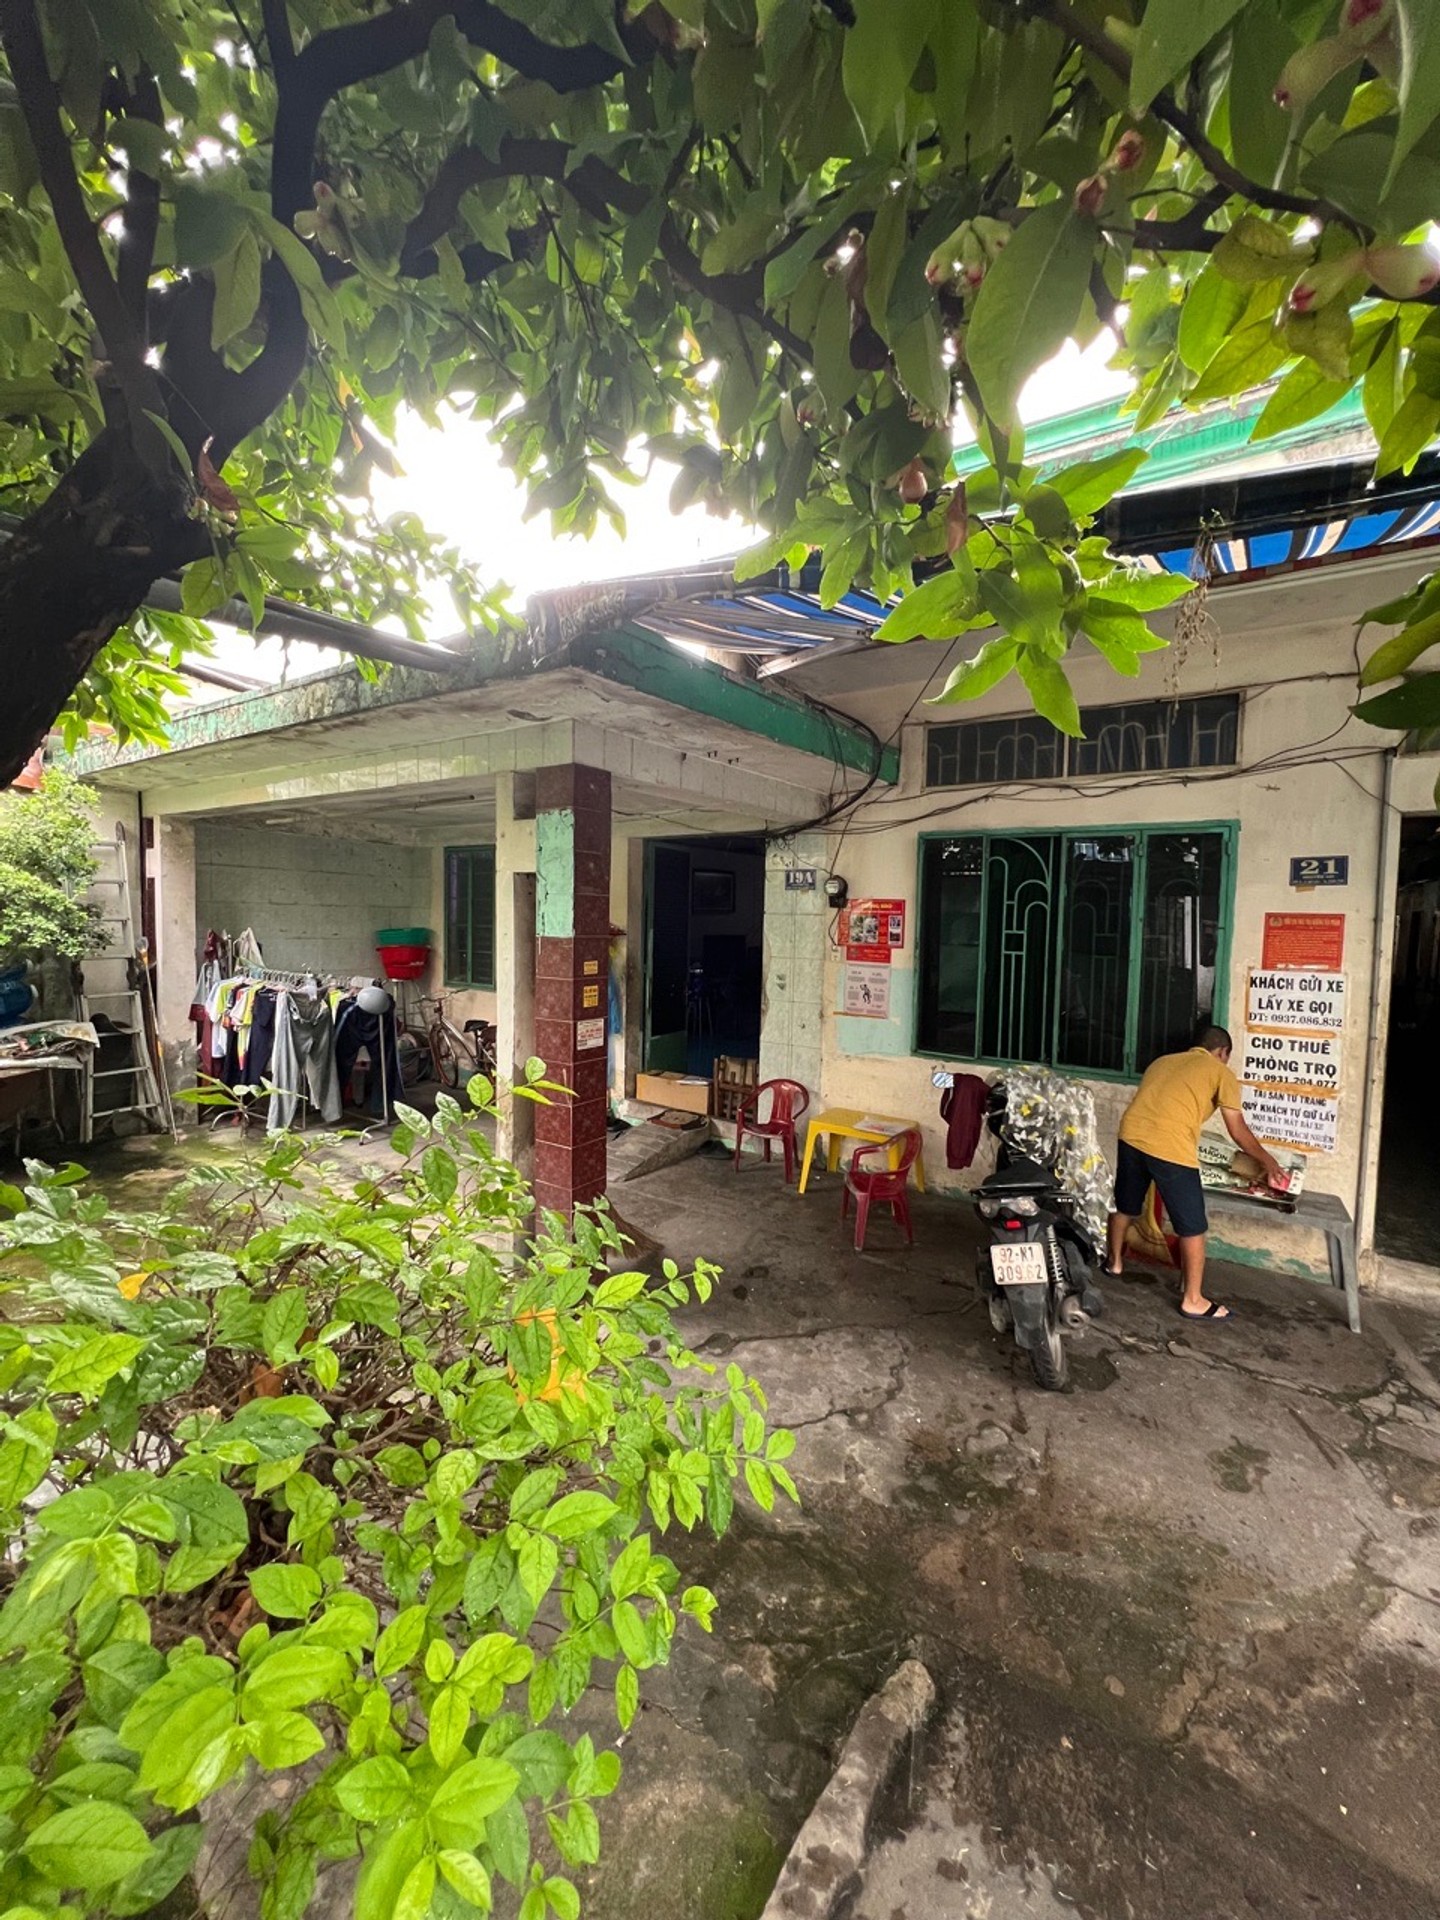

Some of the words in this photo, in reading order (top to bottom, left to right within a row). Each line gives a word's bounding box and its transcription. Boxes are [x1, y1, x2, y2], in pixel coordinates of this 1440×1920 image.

[1300, 859, 1339, 875] 21
[788, 871, 814, 884] 19A
[1249, 974, 1294, 990] KHÁCH
[1299, 974, 1322, 992] GỬI
[1326, 980, 1344, 993] XE
[1258, 993, 1283, 1011] LẤY
[1287, 999, 1305, 1012] XE
[1309, 1000, 1333, 1016] GỌI
[1251, 1036, 1283, 1051] CHO
[1288, 1039, 1331, 1055] THUÊ
[1245, 1055, 1299, 1073] PHÒNG
[1304, 1061, 1337, 1078] TRỌ
[1260, 1103, 1288, 1115] KHÁCH
